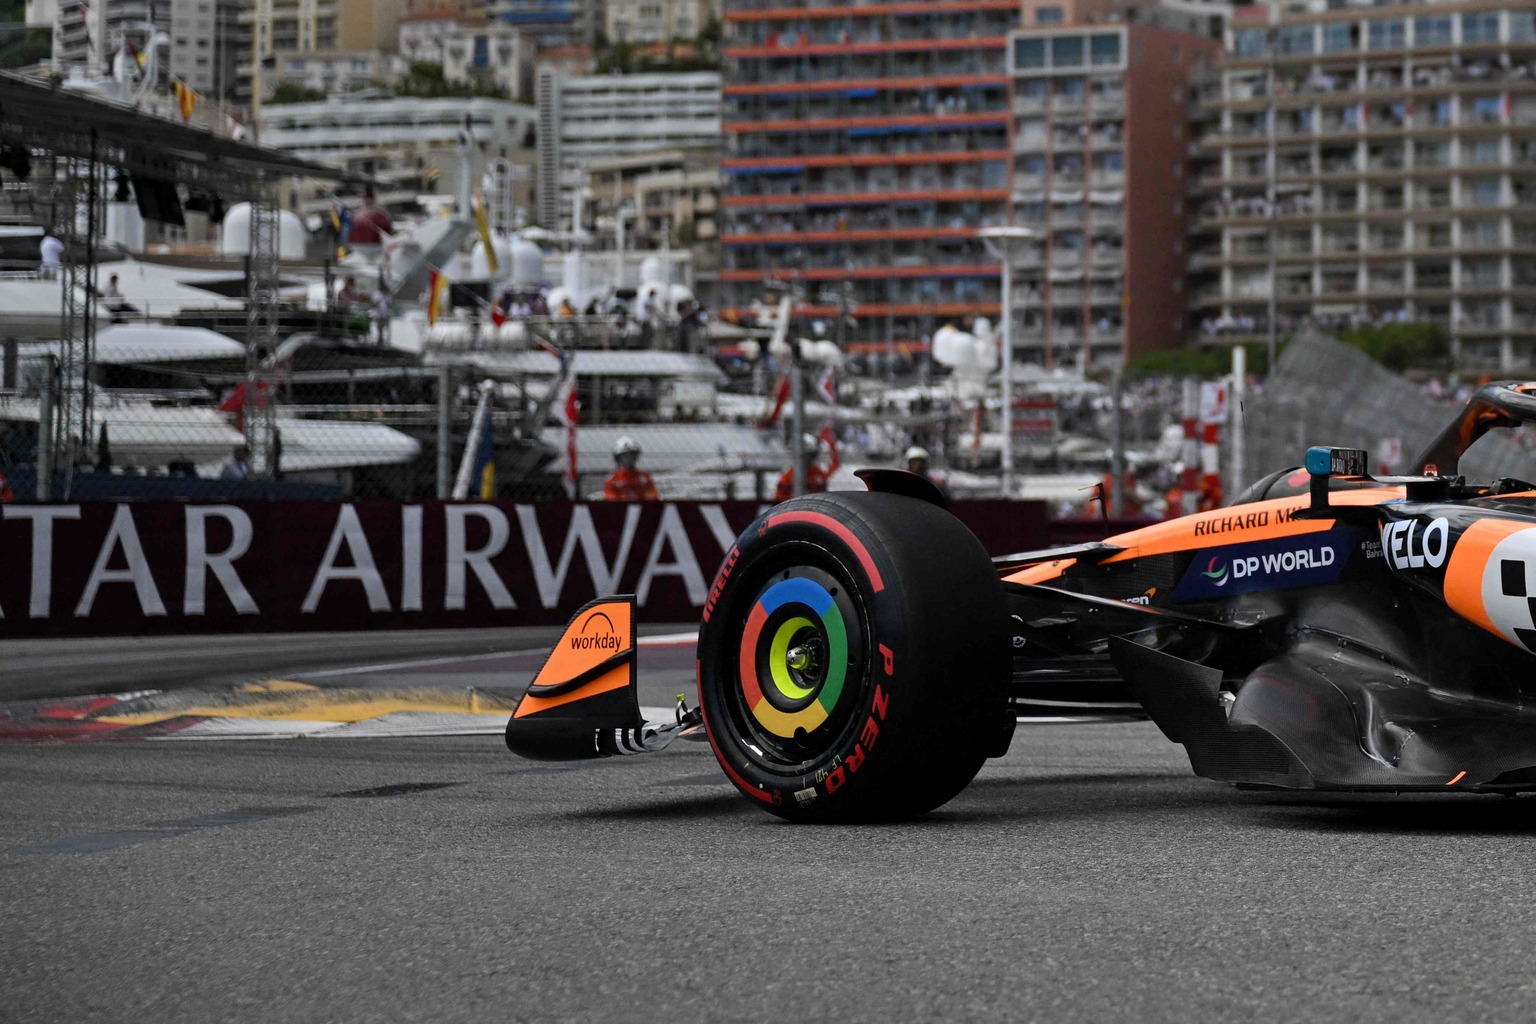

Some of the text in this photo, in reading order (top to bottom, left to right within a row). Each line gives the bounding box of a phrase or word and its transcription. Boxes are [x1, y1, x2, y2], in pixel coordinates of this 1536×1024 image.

[1194, 510, 1269, 537] RICHARD
[1378, 516, 1450, 572] VELO
[0, 502, 260, 618] TAR
[703, 544, 741, 624] PIRELLI
[1233, 546, 1335, 578] DP WORLD
[571, 632, 622, 653] workday
[826, 642, 894, 795] P ZERO
